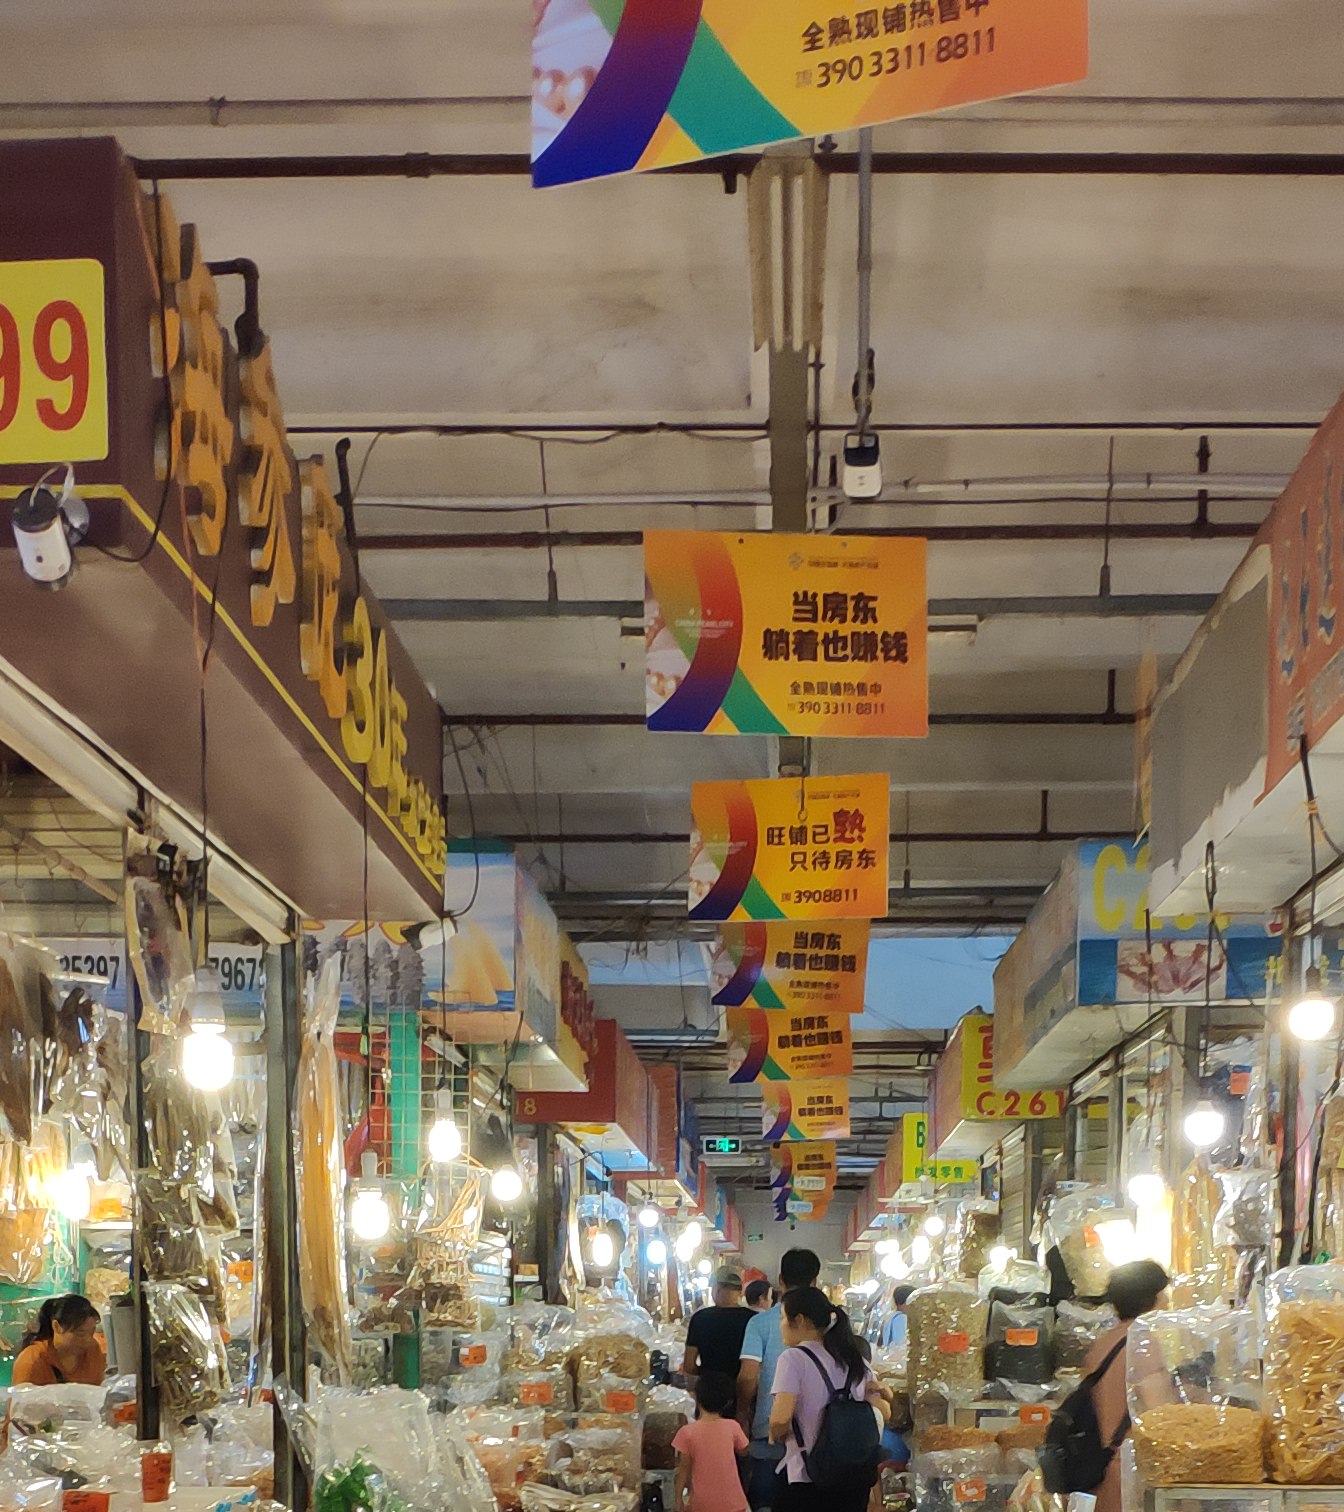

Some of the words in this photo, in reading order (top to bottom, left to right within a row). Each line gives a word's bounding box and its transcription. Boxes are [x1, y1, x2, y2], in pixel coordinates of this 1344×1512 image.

[817, 56, 864, 88] 390
[869, 41, 926, 77] 3311
[935, 26, 995, 63] 8811
[792, 590, 878, 625] 当房东
[762, 628, 909, 664] 躺着也赚钱
[797, 702, 821, 714] 390
[823, 702, 852, 714] 3311
[856, 702, 885, 715] 8811
[766, 808, 867, 846] 旺铺已熟
[789, 848, 876, 872] 只待房东
[794, 889, 859, 904] 3908811
[794, 931, 842, 950] 当房东
